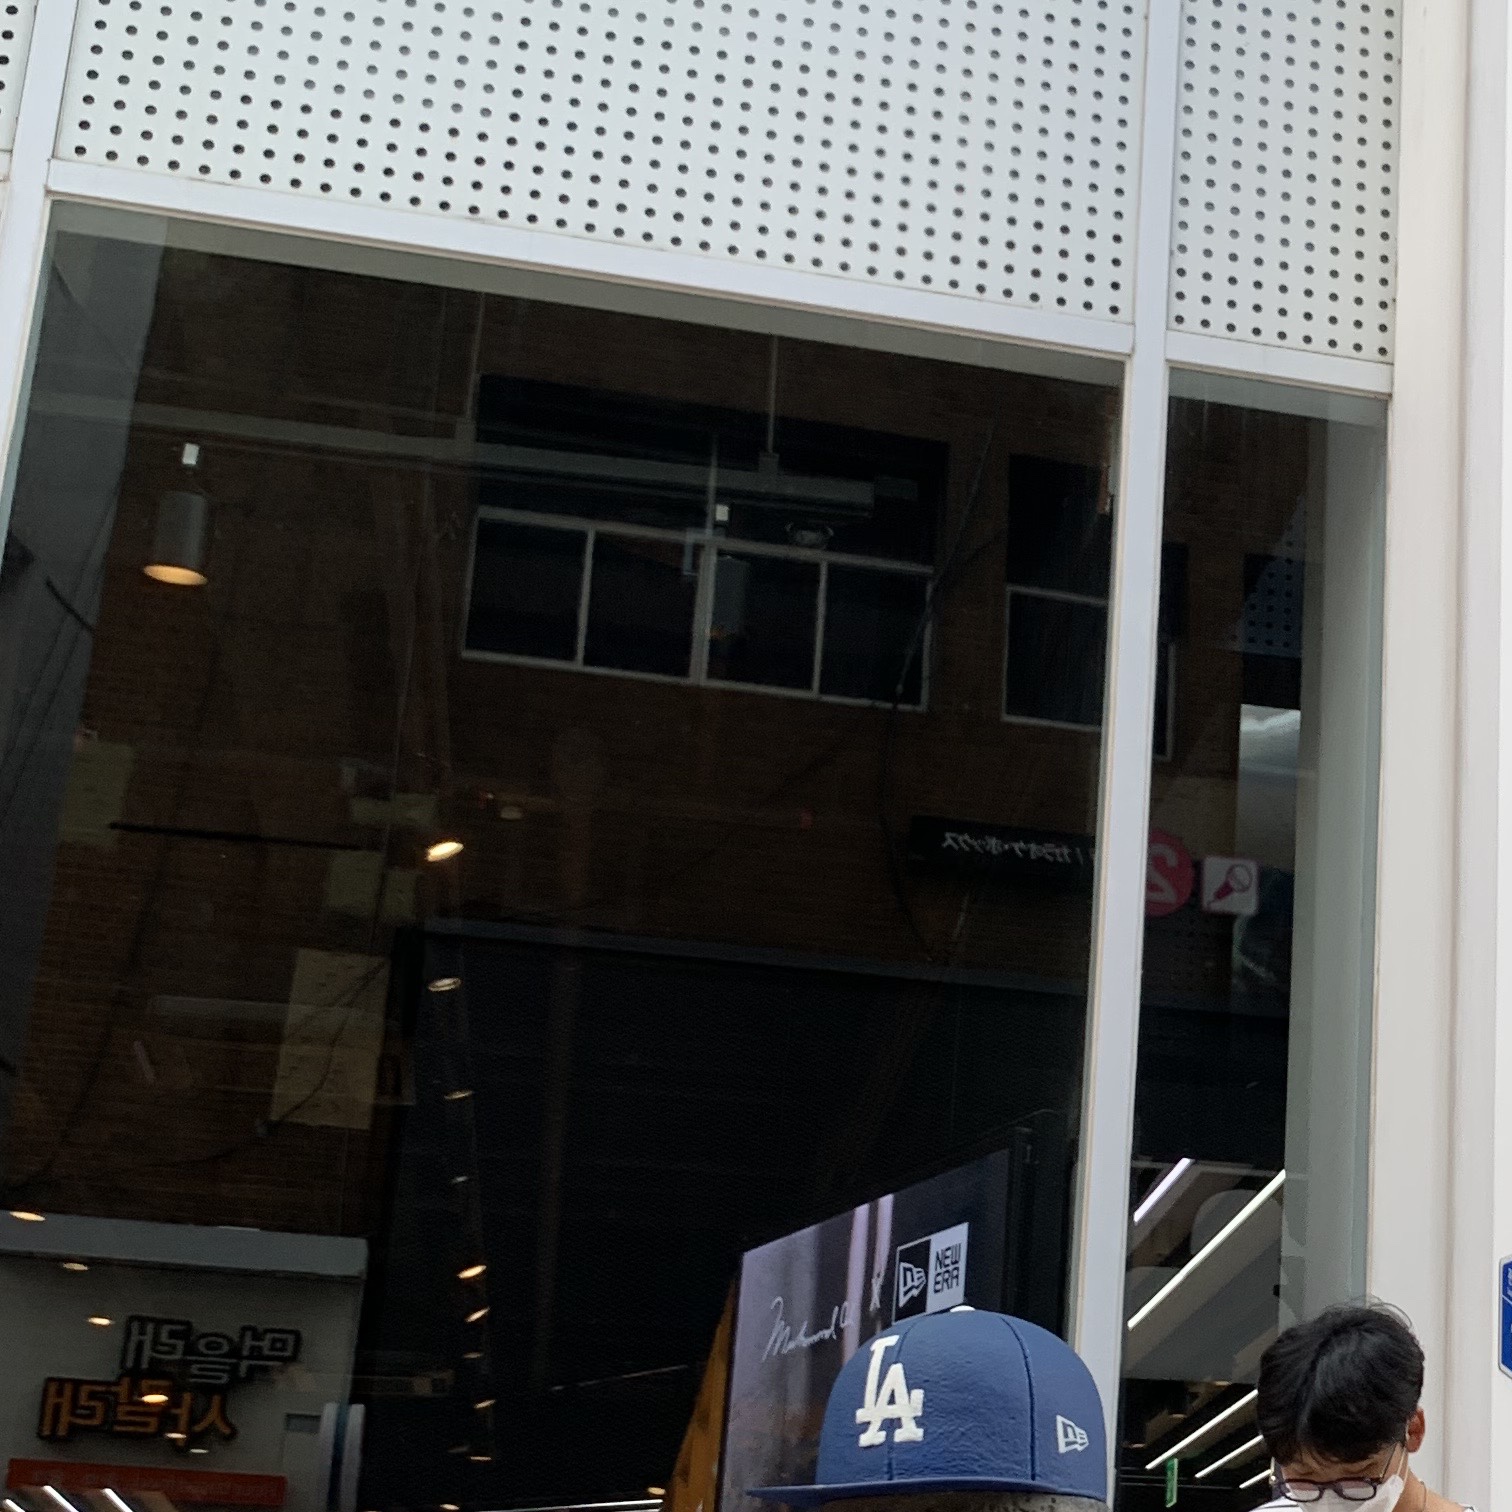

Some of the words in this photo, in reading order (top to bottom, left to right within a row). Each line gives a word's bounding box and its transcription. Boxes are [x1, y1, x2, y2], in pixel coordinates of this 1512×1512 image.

[935, 1242, 962, 1271] NEW
[933, 1267, 960, 1294] ERA
[856, 1335, 925, 1448] LA
